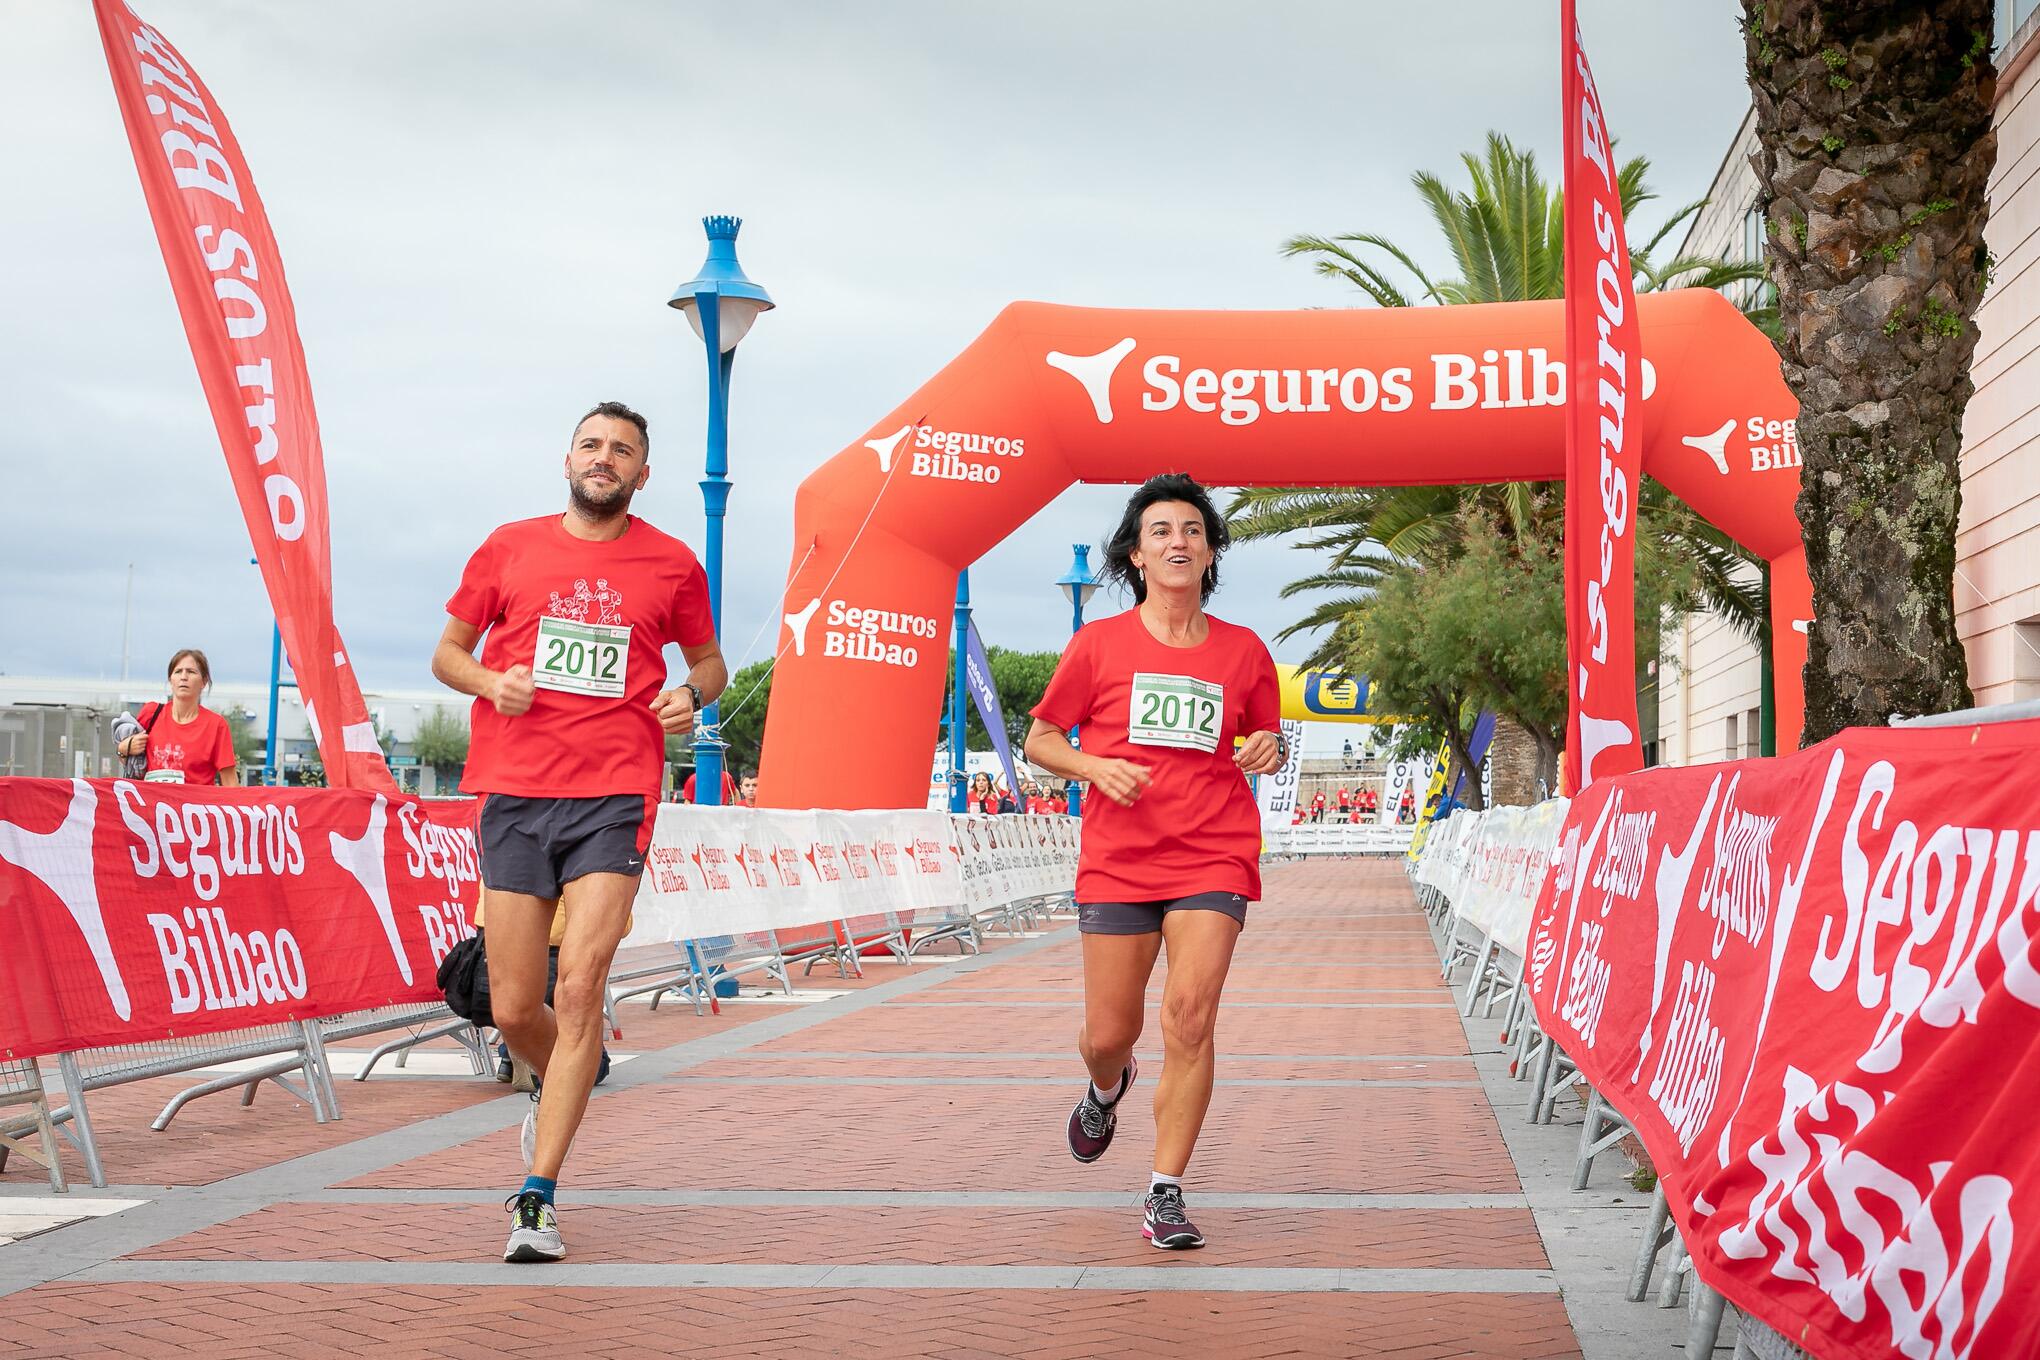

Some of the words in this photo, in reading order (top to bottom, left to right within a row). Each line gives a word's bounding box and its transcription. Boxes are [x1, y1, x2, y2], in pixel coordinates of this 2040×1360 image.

[1141, 354, 1414, 426] Seguros
[914, 425, 1025, 457] Seguros
[910, 452, 1001, 484] Bilbao
[827, 600, 937, 639] Seguros
[544, 638, 619, 679] 2012
[823, 631, 918, 668] Bilbao
[1140, 692, 1215, 734] 2012
[113, 780, 306, 901] Seguros
[397, 801, 481, 899] Segur
[146, 906, 308, 1015] Bilbao
